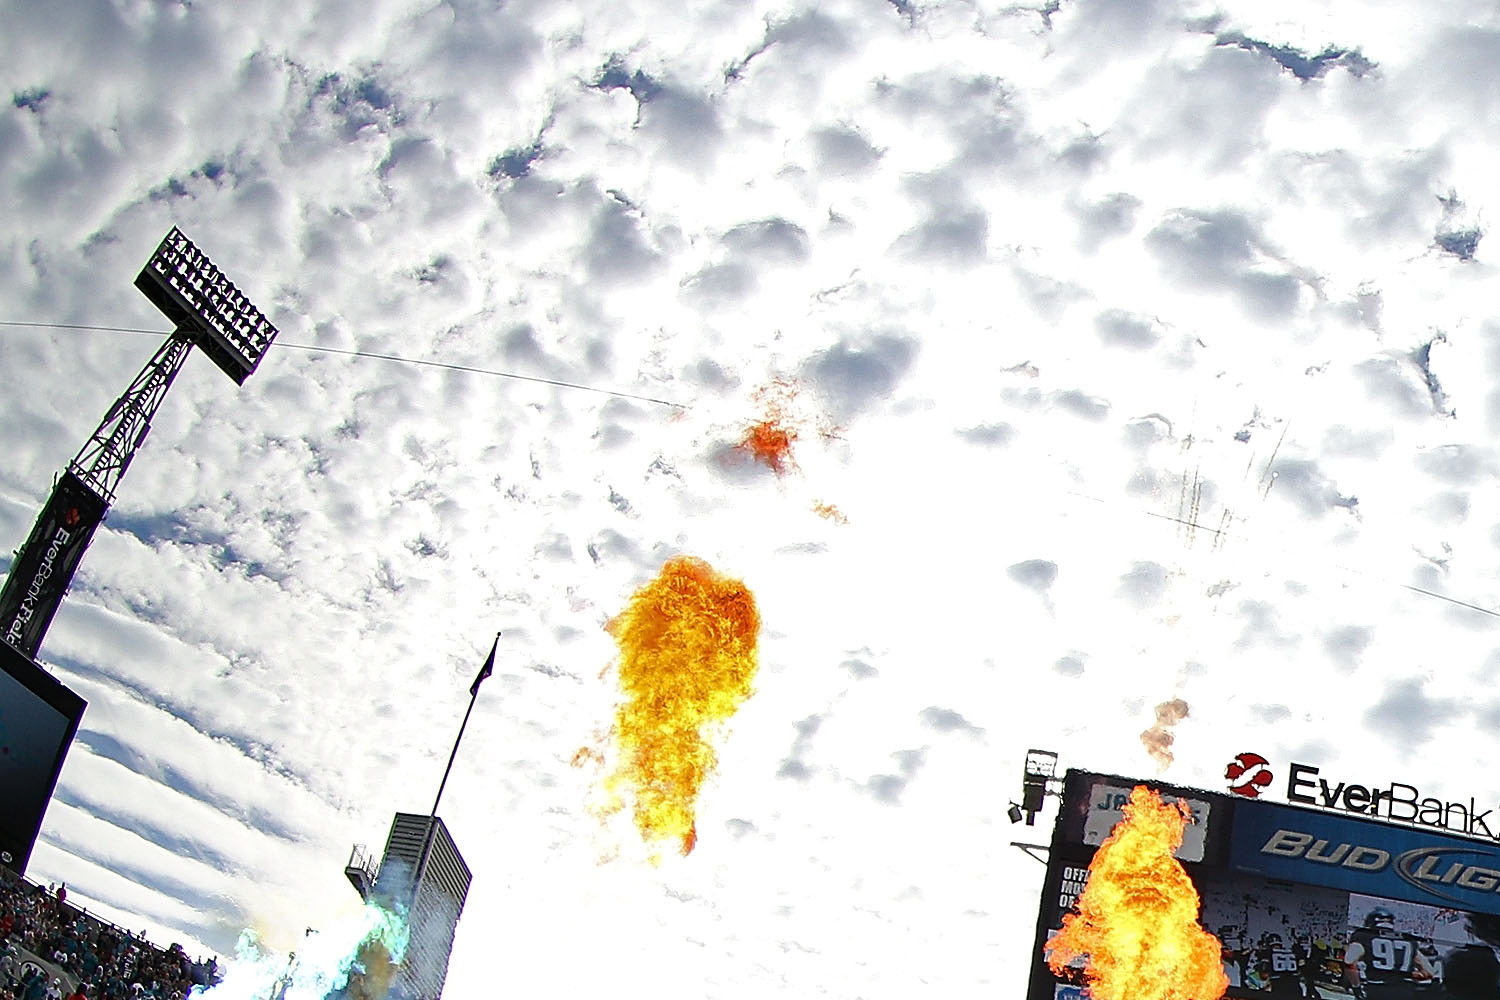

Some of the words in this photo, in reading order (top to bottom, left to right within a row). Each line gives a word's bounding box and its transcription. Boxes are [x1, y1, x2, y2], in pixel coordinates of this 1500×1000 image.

[24, 527, 70, 606] EverBank
[1286, 763, 1499, 842] EverBank
[1260, 829, 1390, 872] BUD
[1371, 937, 1414, 972] 97
